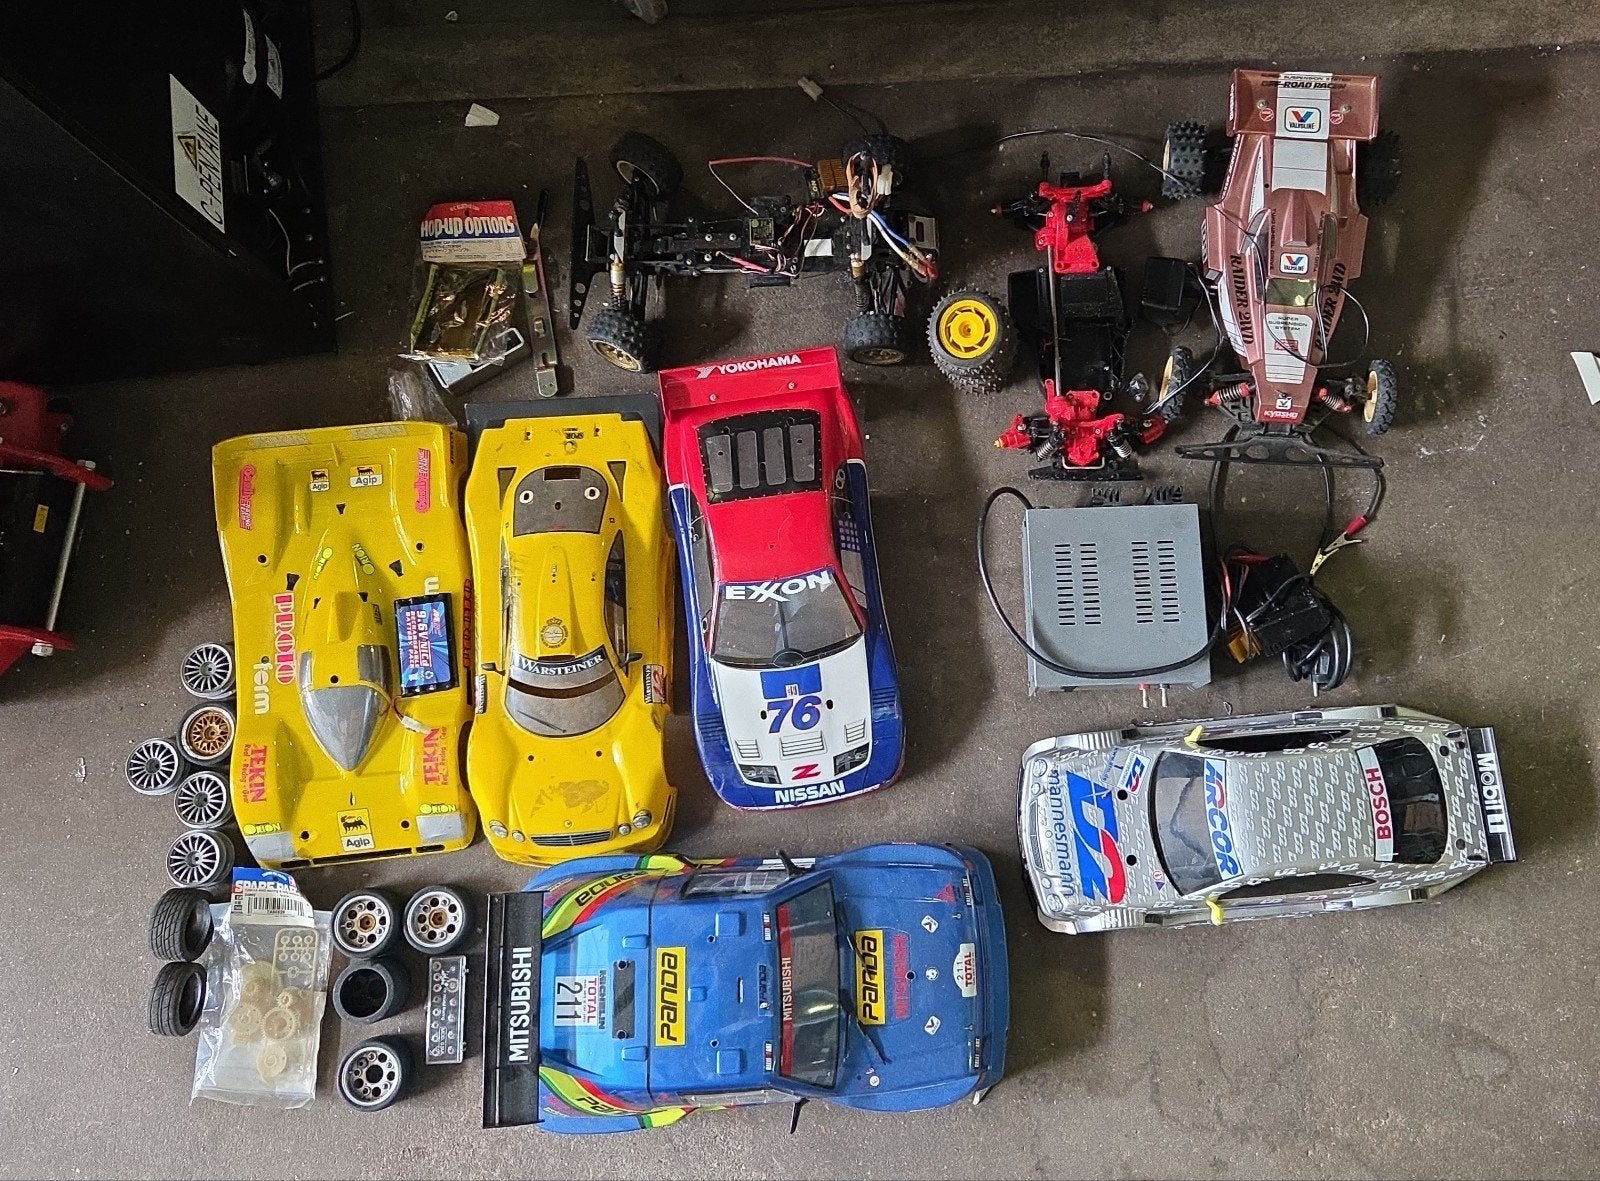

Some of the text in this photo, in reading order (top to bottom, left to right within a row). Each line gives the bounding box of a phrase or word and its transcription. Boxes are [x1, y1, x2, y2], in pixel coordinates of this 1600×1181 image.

[1230, 255, 1254, 345] RAIDER 2WD
[717, 353, 802, 375] YOKOHAMA
[1263, 409, 1299, 419] KYOSHO
[311, 481, 328, 490] Agip
[355, 474, 378, 487] Agip
[725, 570, 833, 603] EXXON
[518, 653, 604, 677] WARSTEINER
[766, 695, 822, 734] 76
[422, 728, 440, 786] TEKIN
[791, 763, 822, 781] Z
[249, 745, 267, 803] TEKIN
[775, 780, 846, 804] NISSAN
[1364, 767, 1393, 840] BOSCH
[419, 803, 457, 815] ORION
[243, 823, 281, 836] ORION
[345, 837, 371, 848] Agip
[1048, 769, 1076, 897] mannesmann
[956, 961, 964, 981] 211
[964, 951, 972, 988] TOTAL
[508, 946, 533, 1063] MITSUBISHI
[556, 981, 584, 1019] 211
[587, 977, 598, 1024] TOTAL
[781, 956, 793, 1022] MITSUBISHI
